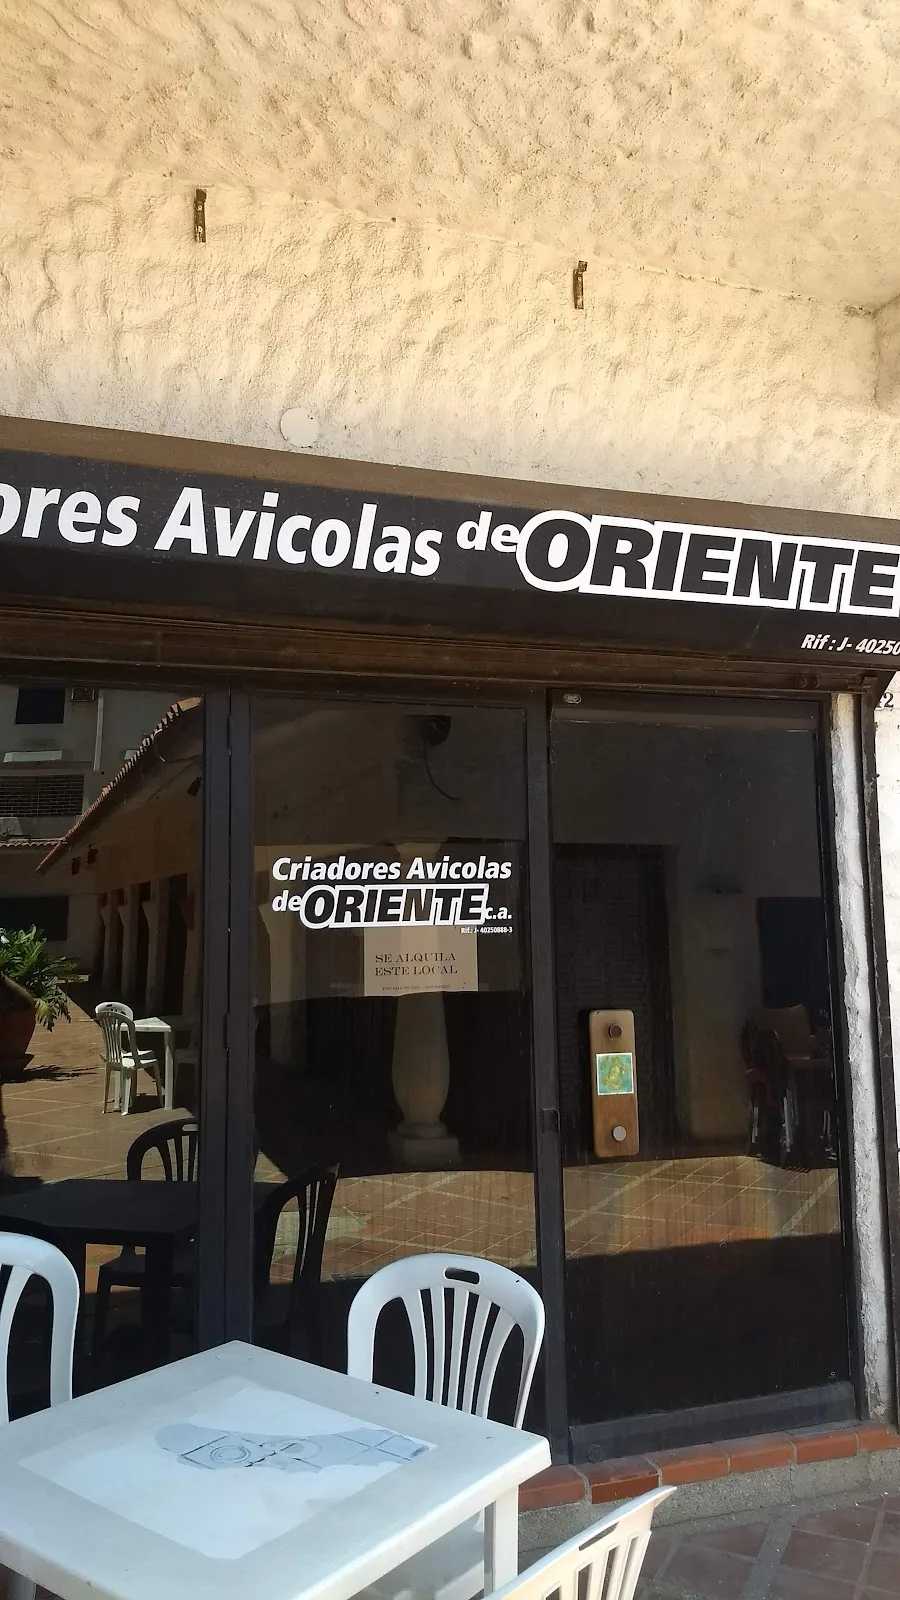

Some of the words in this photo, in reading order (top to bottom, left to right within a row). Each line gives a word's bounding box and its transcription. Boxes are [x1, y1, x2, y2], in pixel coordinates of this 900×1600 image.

[154, 486, 443, 578] Avicolas
[515, 510, 900, 618] ORIENTE
[272, 856, 401, 881] Criadores
[406, 856, 512, 880] Avicolas
[299, 883, 490, 930] ORIENTE
[485, 905, 513, 920] c.a.
[375, 953, 392, 963] SE
[396, 952, 456, 962] ALQUILA
[375, 966, 410, 977] ESTE
[413, 965, 458, 975] LOCAL
